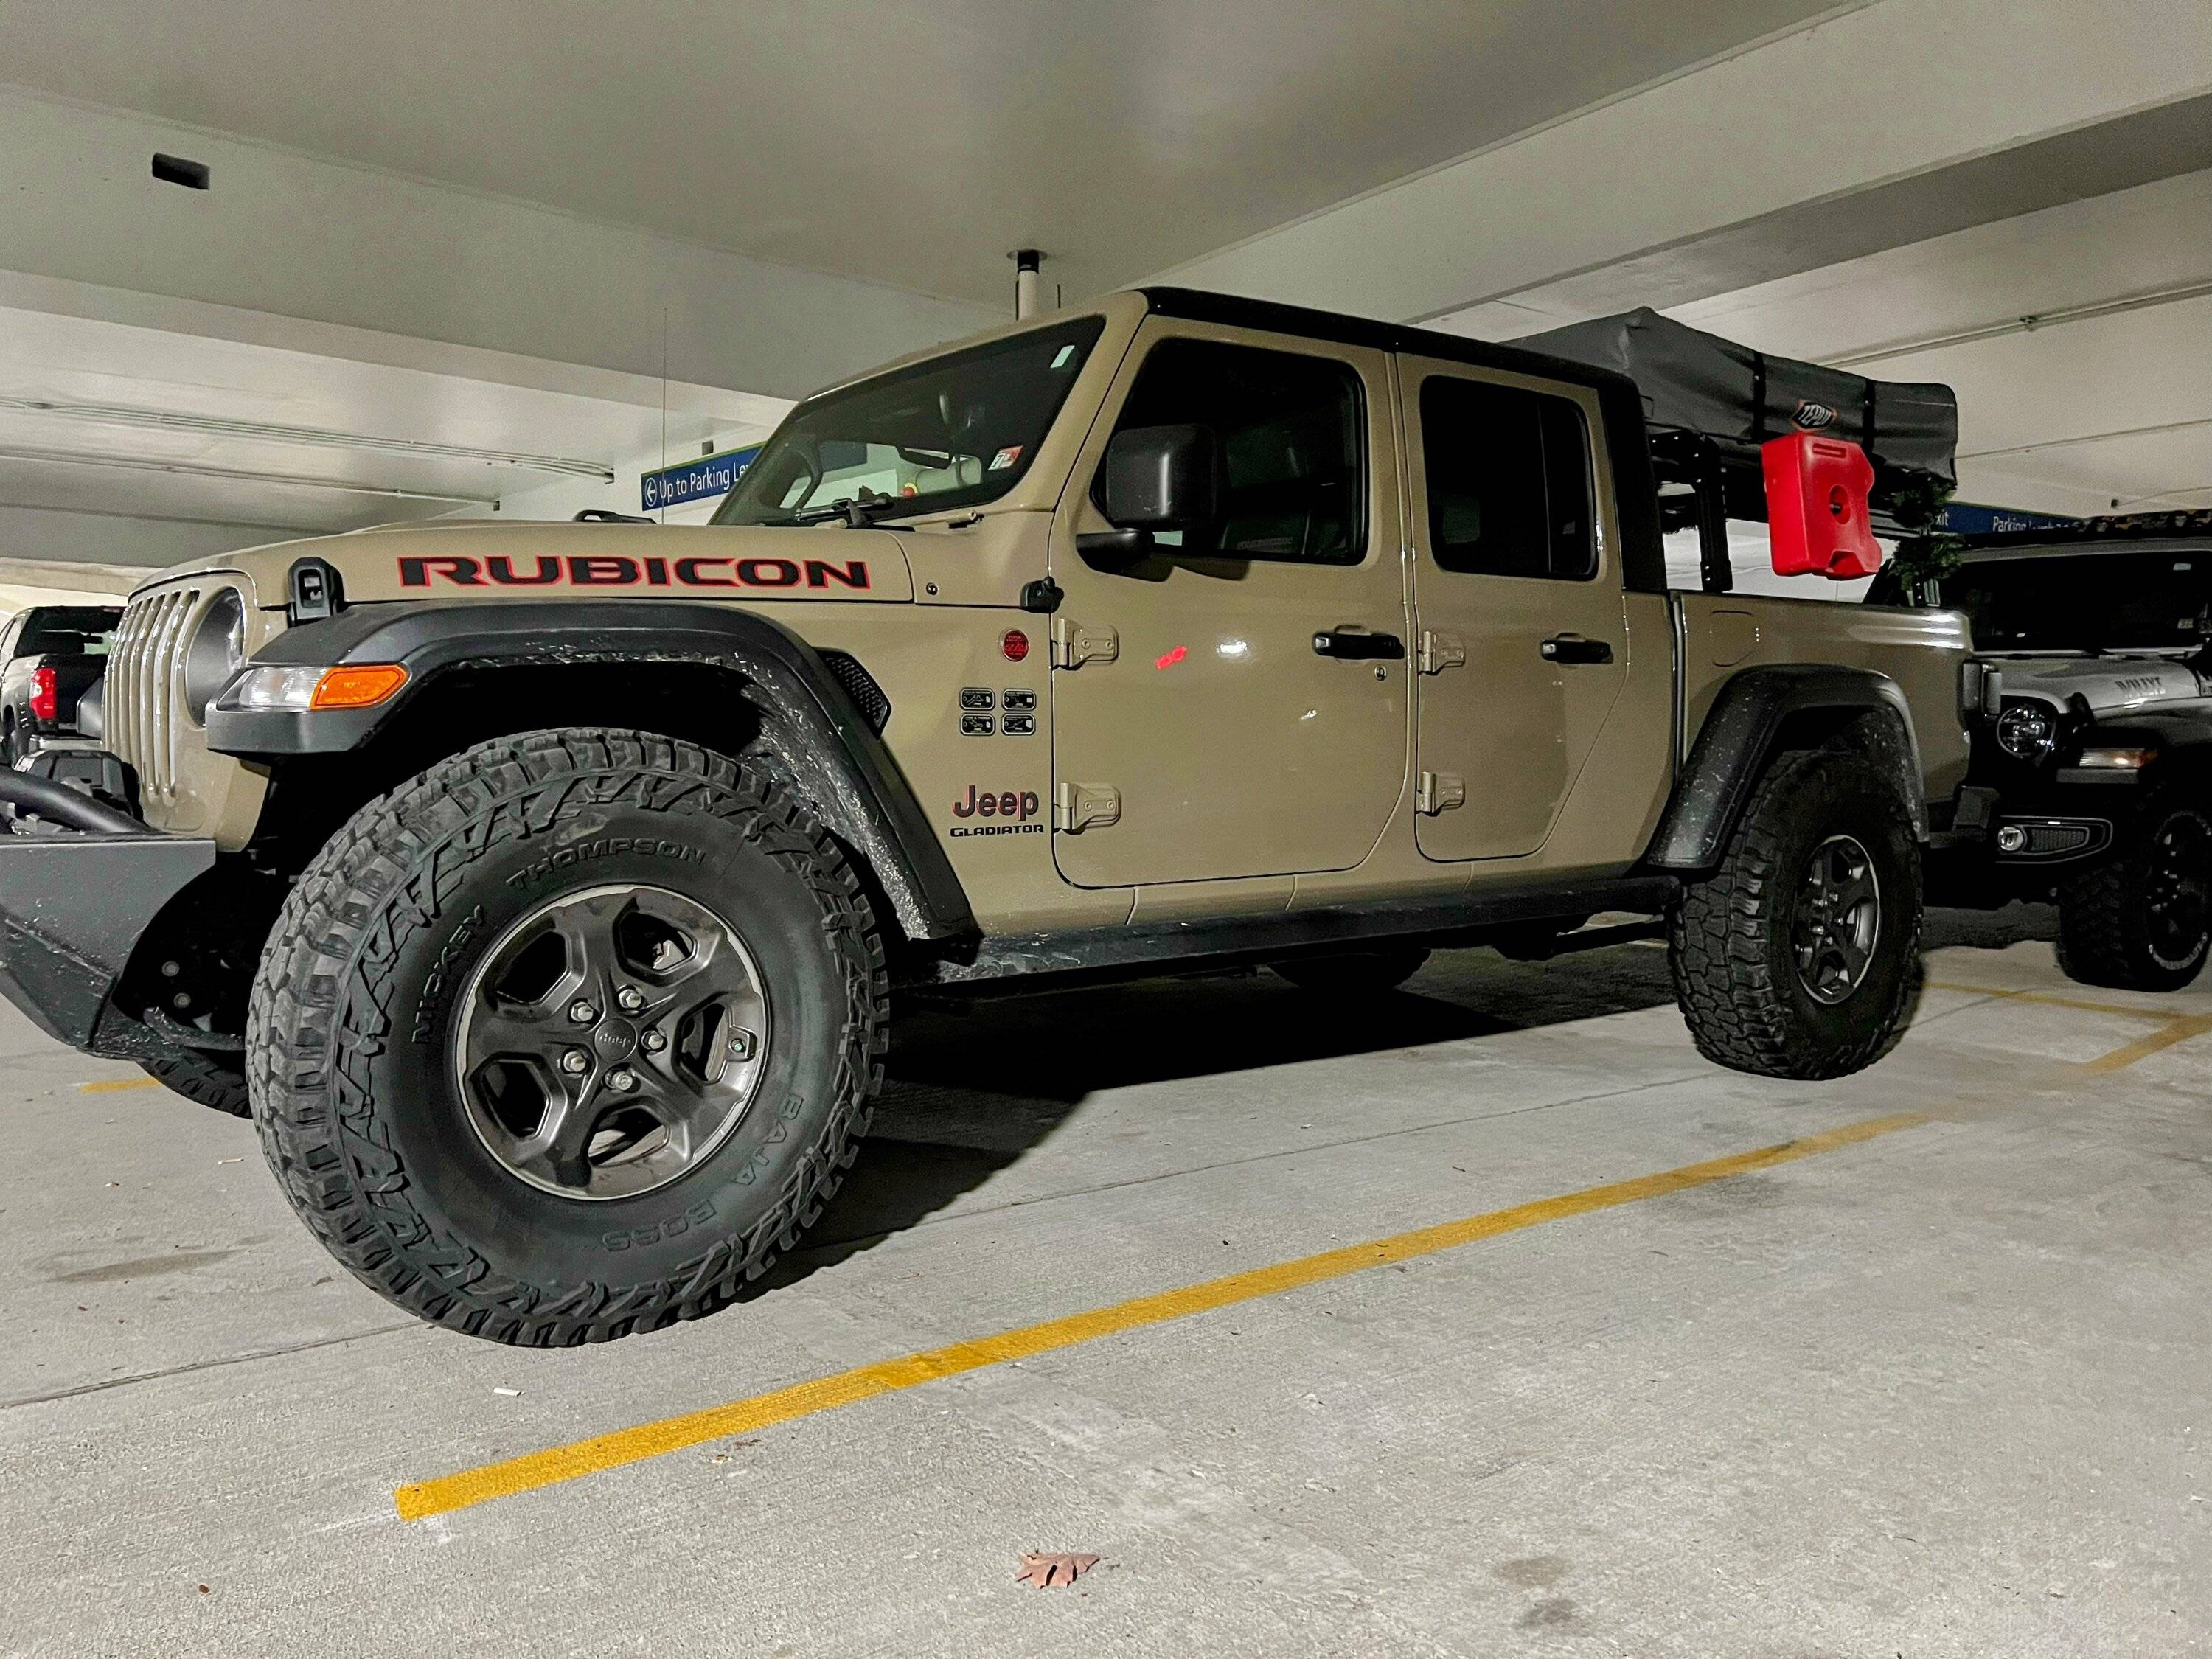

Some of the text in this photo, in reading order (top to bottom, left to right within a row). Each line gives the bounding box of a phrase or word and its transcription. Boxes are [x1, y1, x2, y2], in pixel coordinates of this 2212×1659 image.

[659, 462, 750, 503] Up to Parking Le
[1934, 509, 1949, 526] xit
[397, 554, 872, 590] RUBICON
[951, 784, 1039, 822] Jeep
[950, 824, 1045, 838] GLADIATOR
[411, 837, 706, 1043] MICKEY THOMPSON
[602, 1091, 804, 1252] BAJA BOSS
